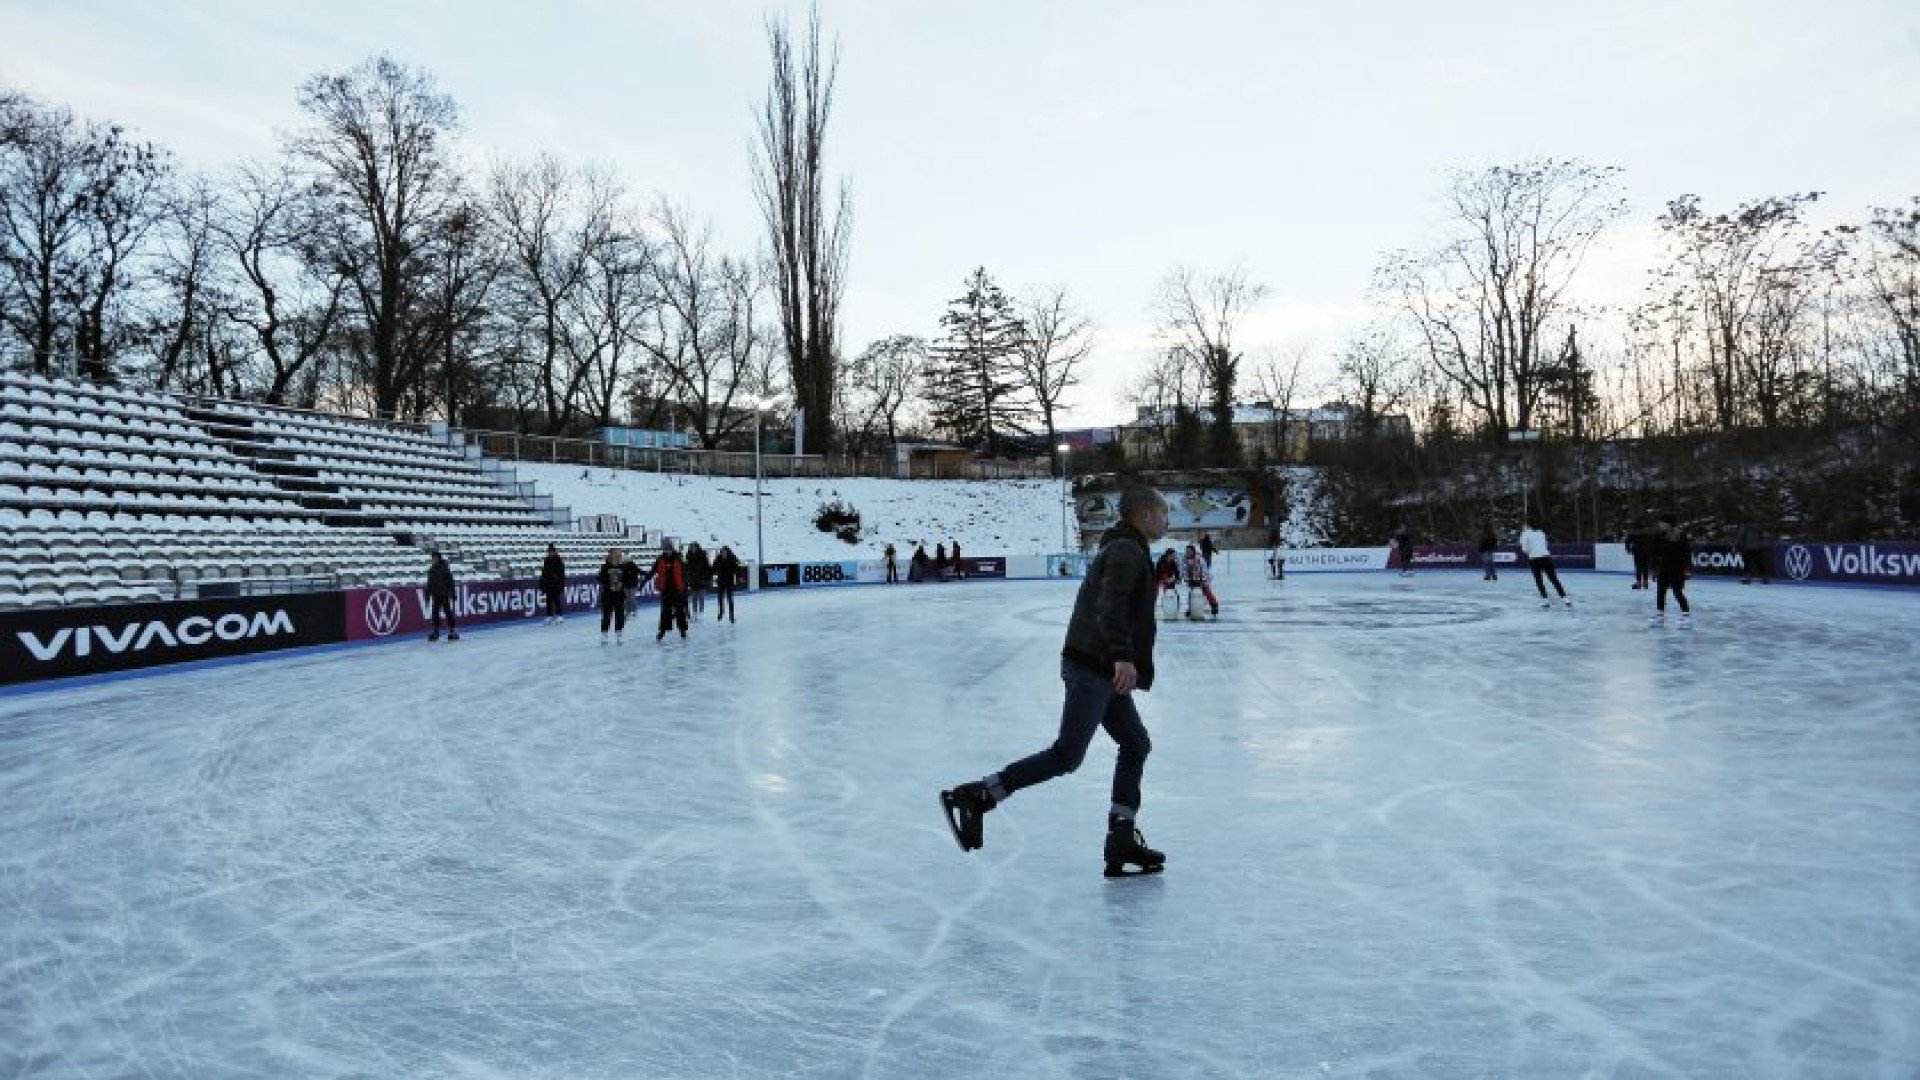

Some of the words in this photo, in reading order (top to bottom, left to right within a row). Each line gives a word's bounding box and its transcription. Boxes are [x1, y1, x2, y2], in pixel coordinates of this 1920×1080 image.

[1288, 554, 1370, 565] SUTHERLAND
[16, 609, 295, 661] VIVACOM
[366, 588, 400, 635] VW
[415, 584, 547, 620] Vlkswage
